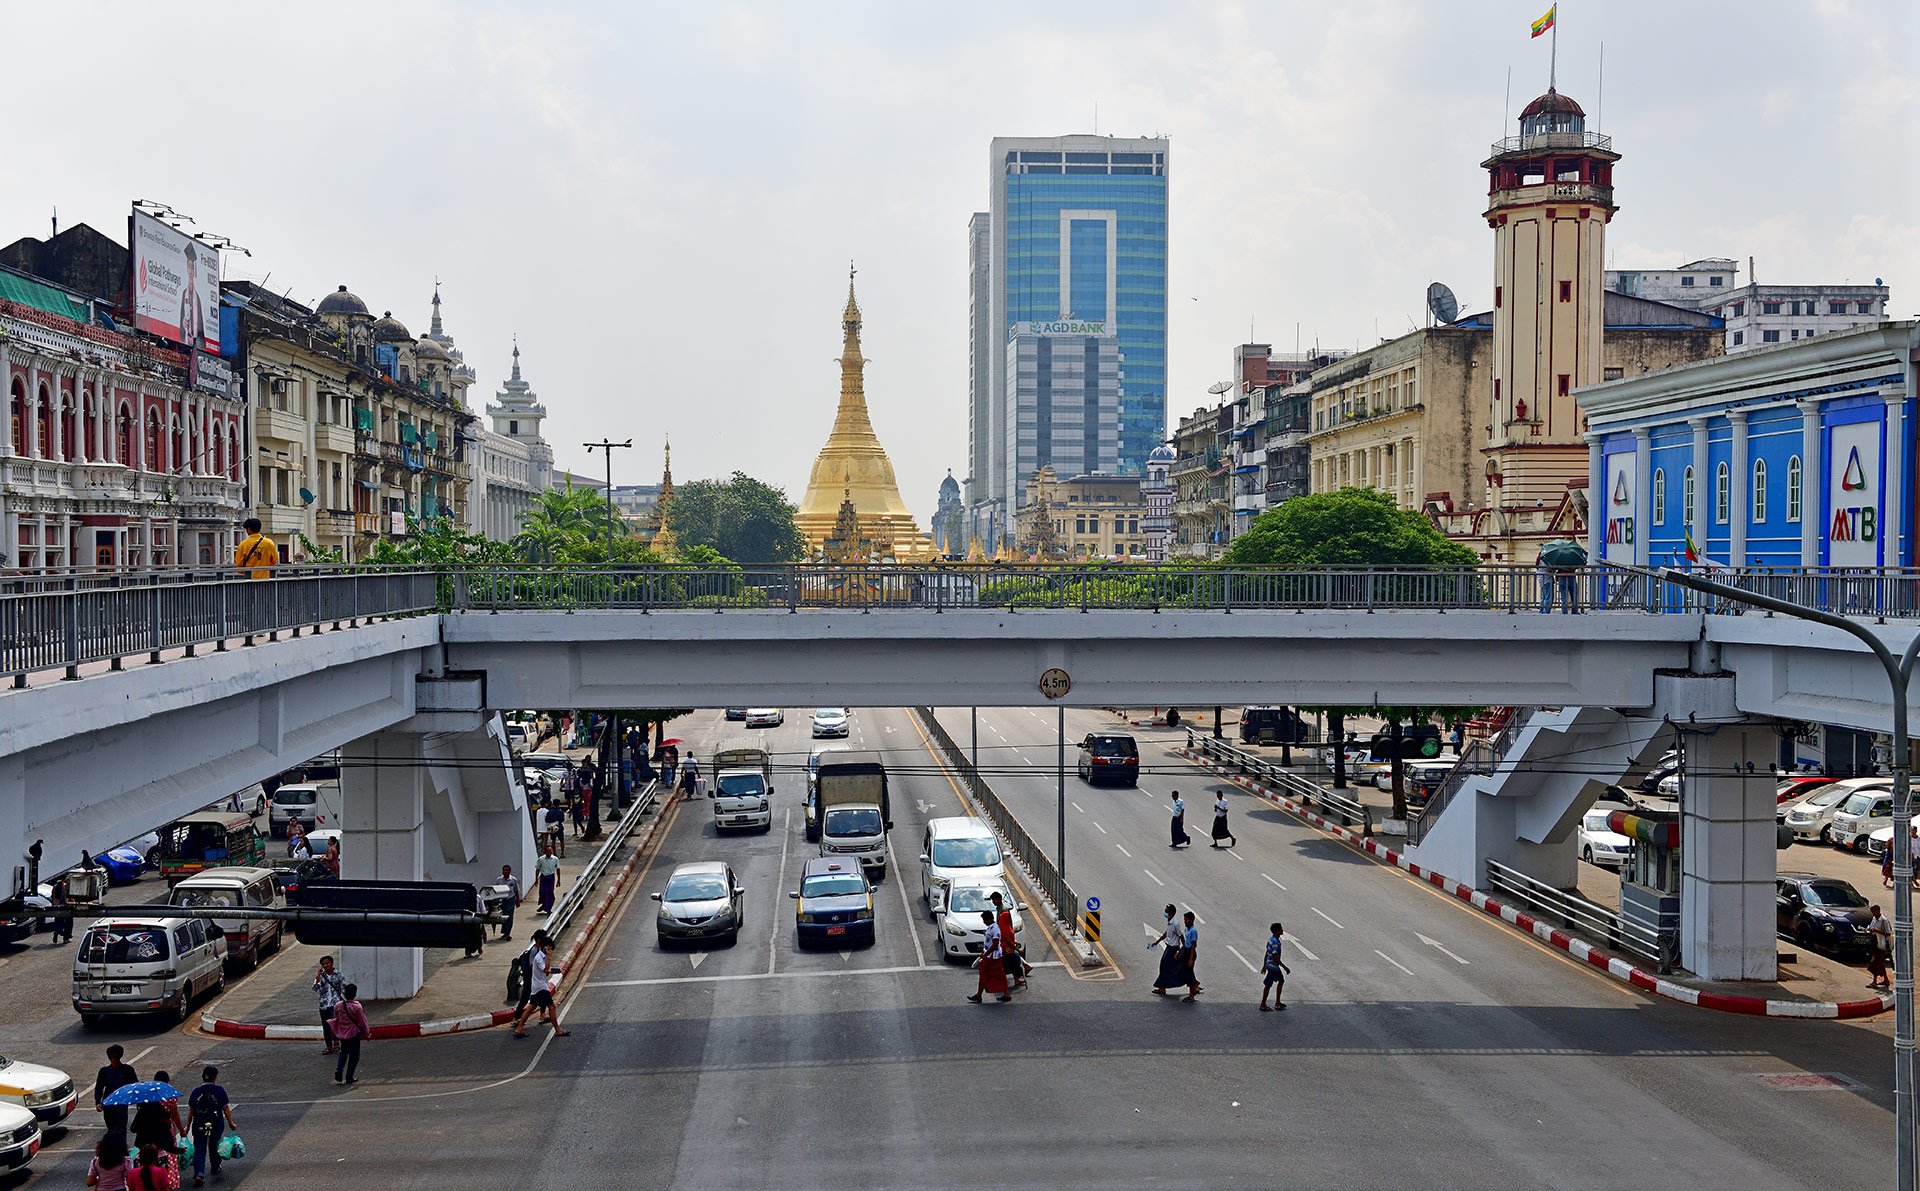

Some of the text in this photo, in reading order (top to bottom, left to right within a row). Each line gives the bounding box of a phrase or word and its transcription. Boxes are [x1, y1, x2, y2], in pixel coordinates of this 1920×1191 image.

[148, 260, 181, 288] Global Pathways
[1607, 517, 1634, 544] MTB
[1831, 507, 1876, 542] MTB
[1043, 678, 1067, 688] 4.5m
